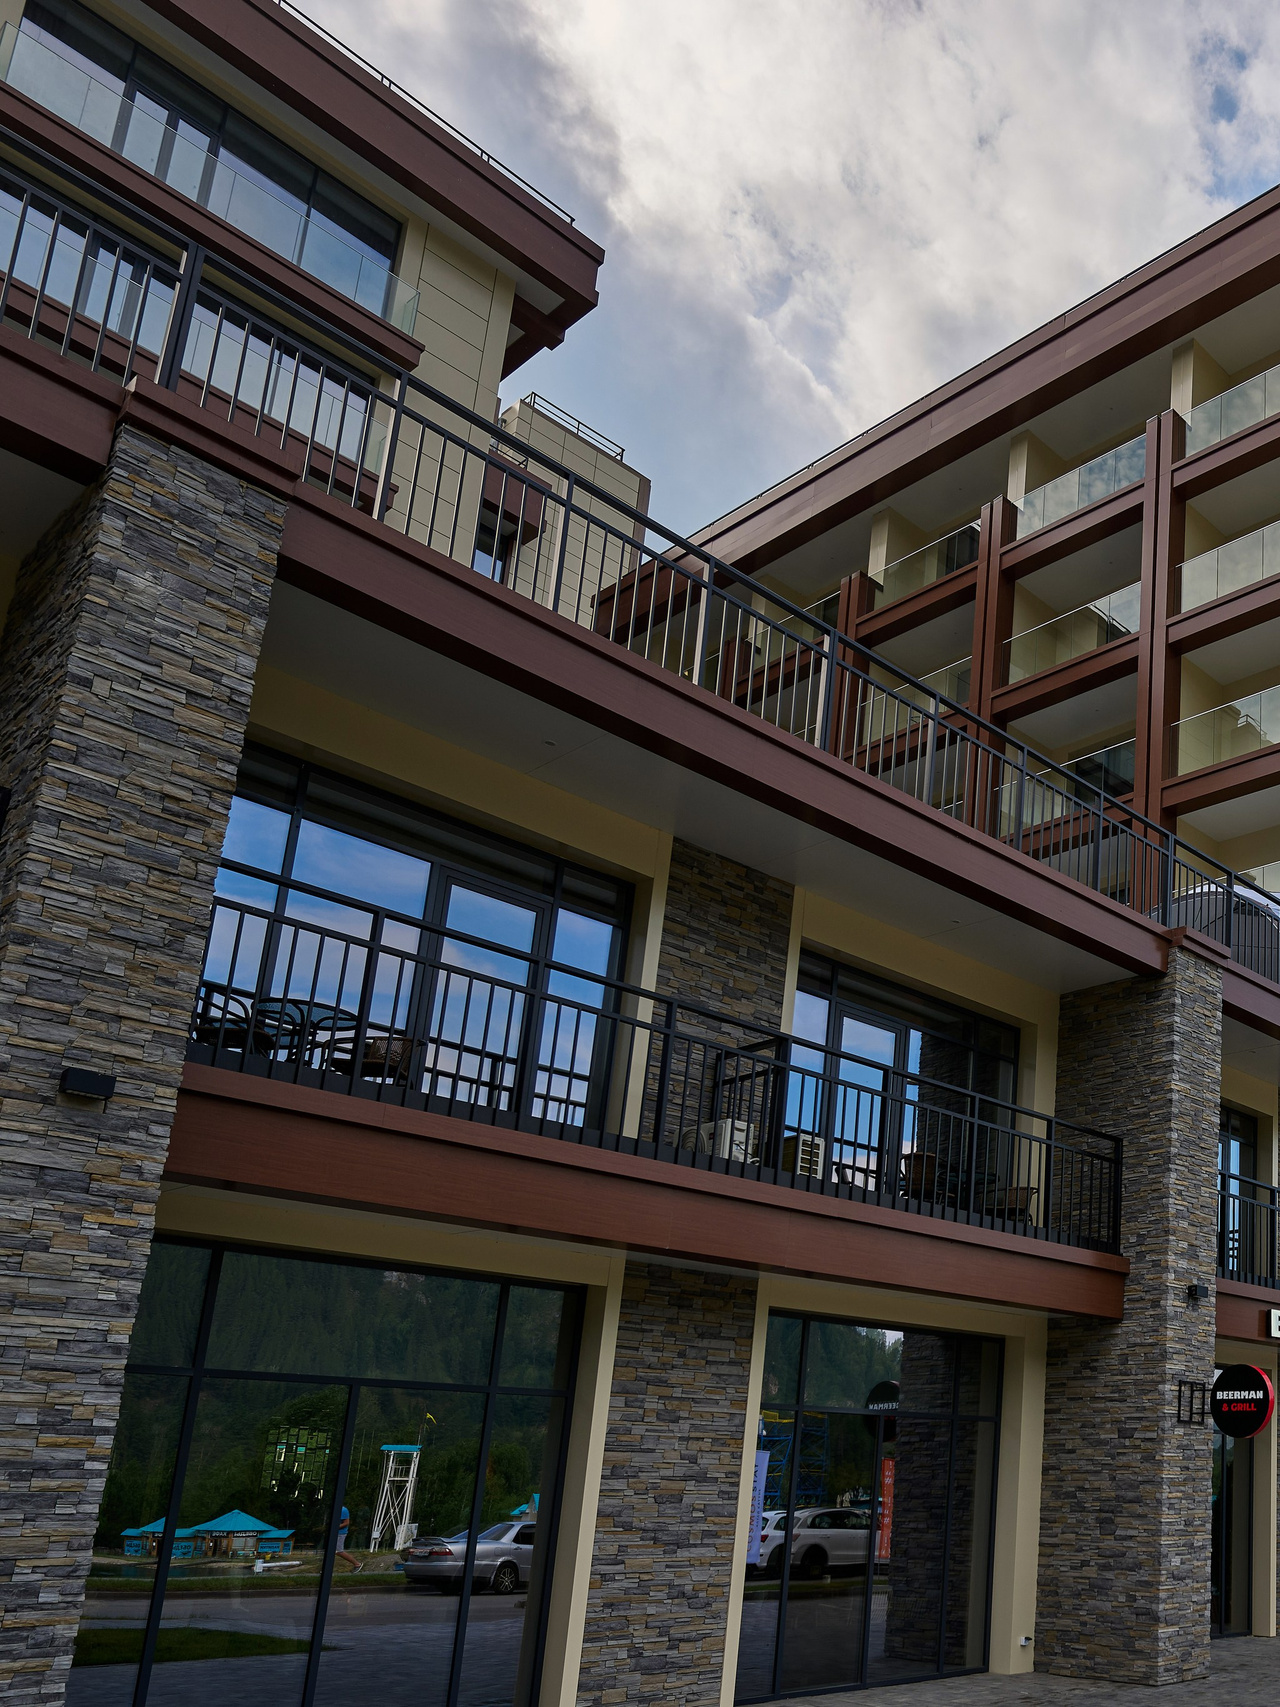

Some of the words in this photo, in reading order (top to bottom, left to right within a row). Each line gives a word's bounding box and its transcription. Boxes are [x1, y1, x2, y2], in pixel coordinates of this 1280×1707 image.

[1216, 1390, 1264, 1400] BEERMAN
[1222, 1402, 1229, 1412] &
[1230, 1402, 1257, 1412] GRILL
